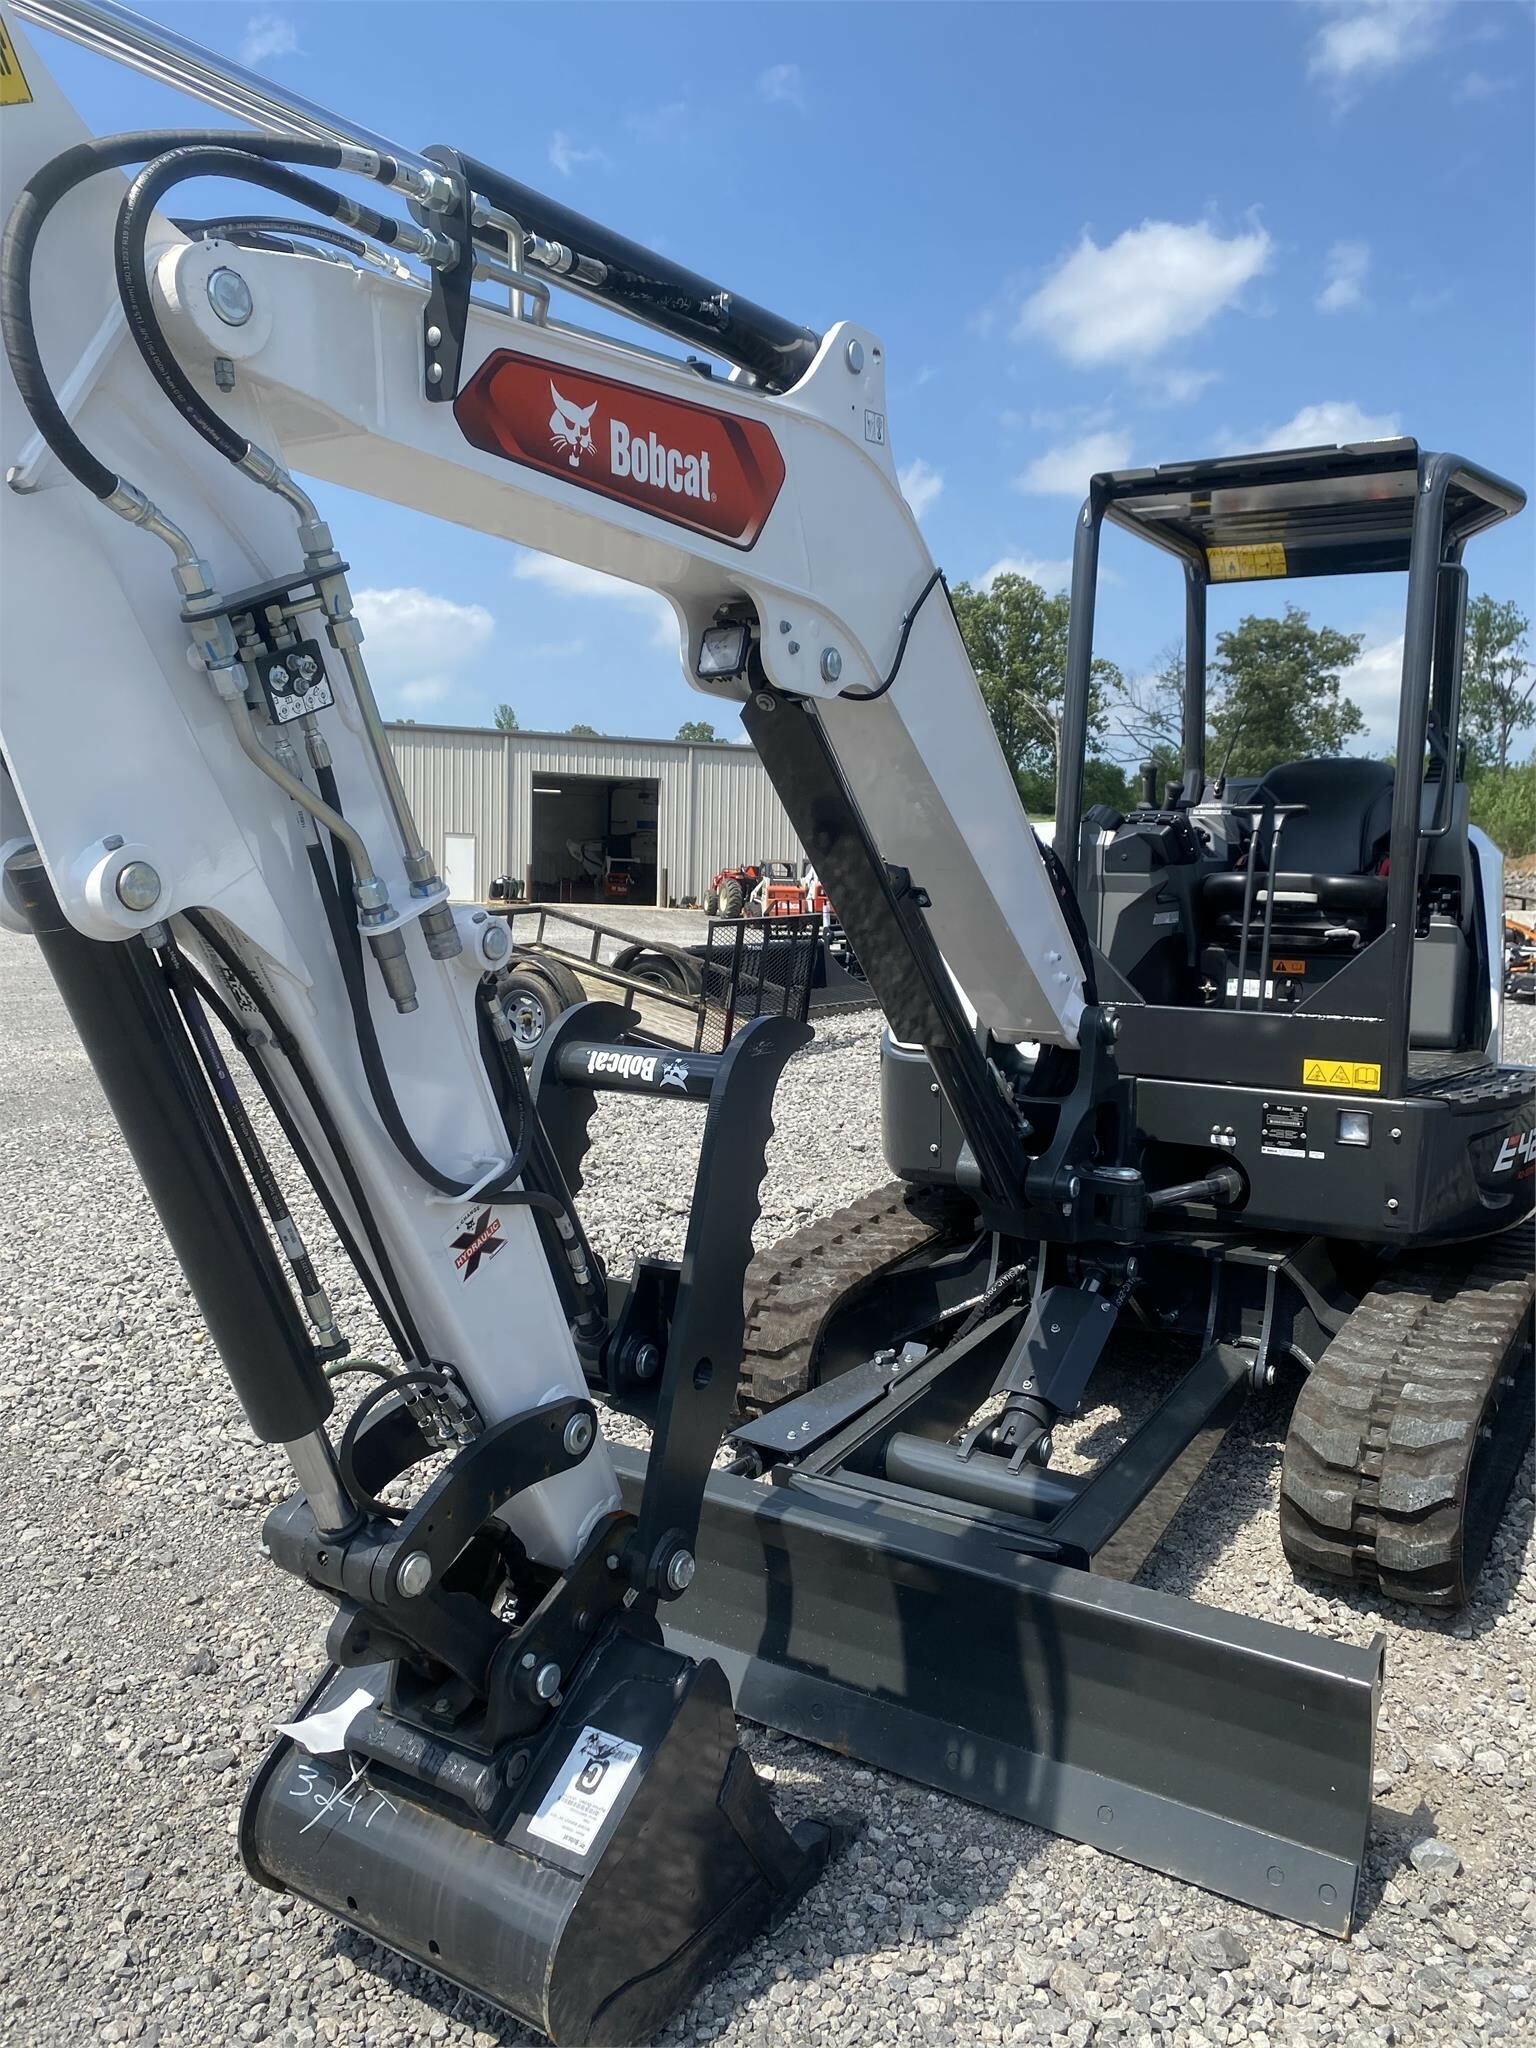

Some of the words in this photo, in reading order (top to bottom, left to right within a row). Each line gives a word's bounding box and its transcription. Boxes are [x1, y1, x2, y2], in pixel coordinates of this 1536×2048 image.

[610, 418, 711, 502] Bobcat
[587, 1050, 658, 1082] Bobcat
[456, 1221, 500, 1267] HYDRAULIC
